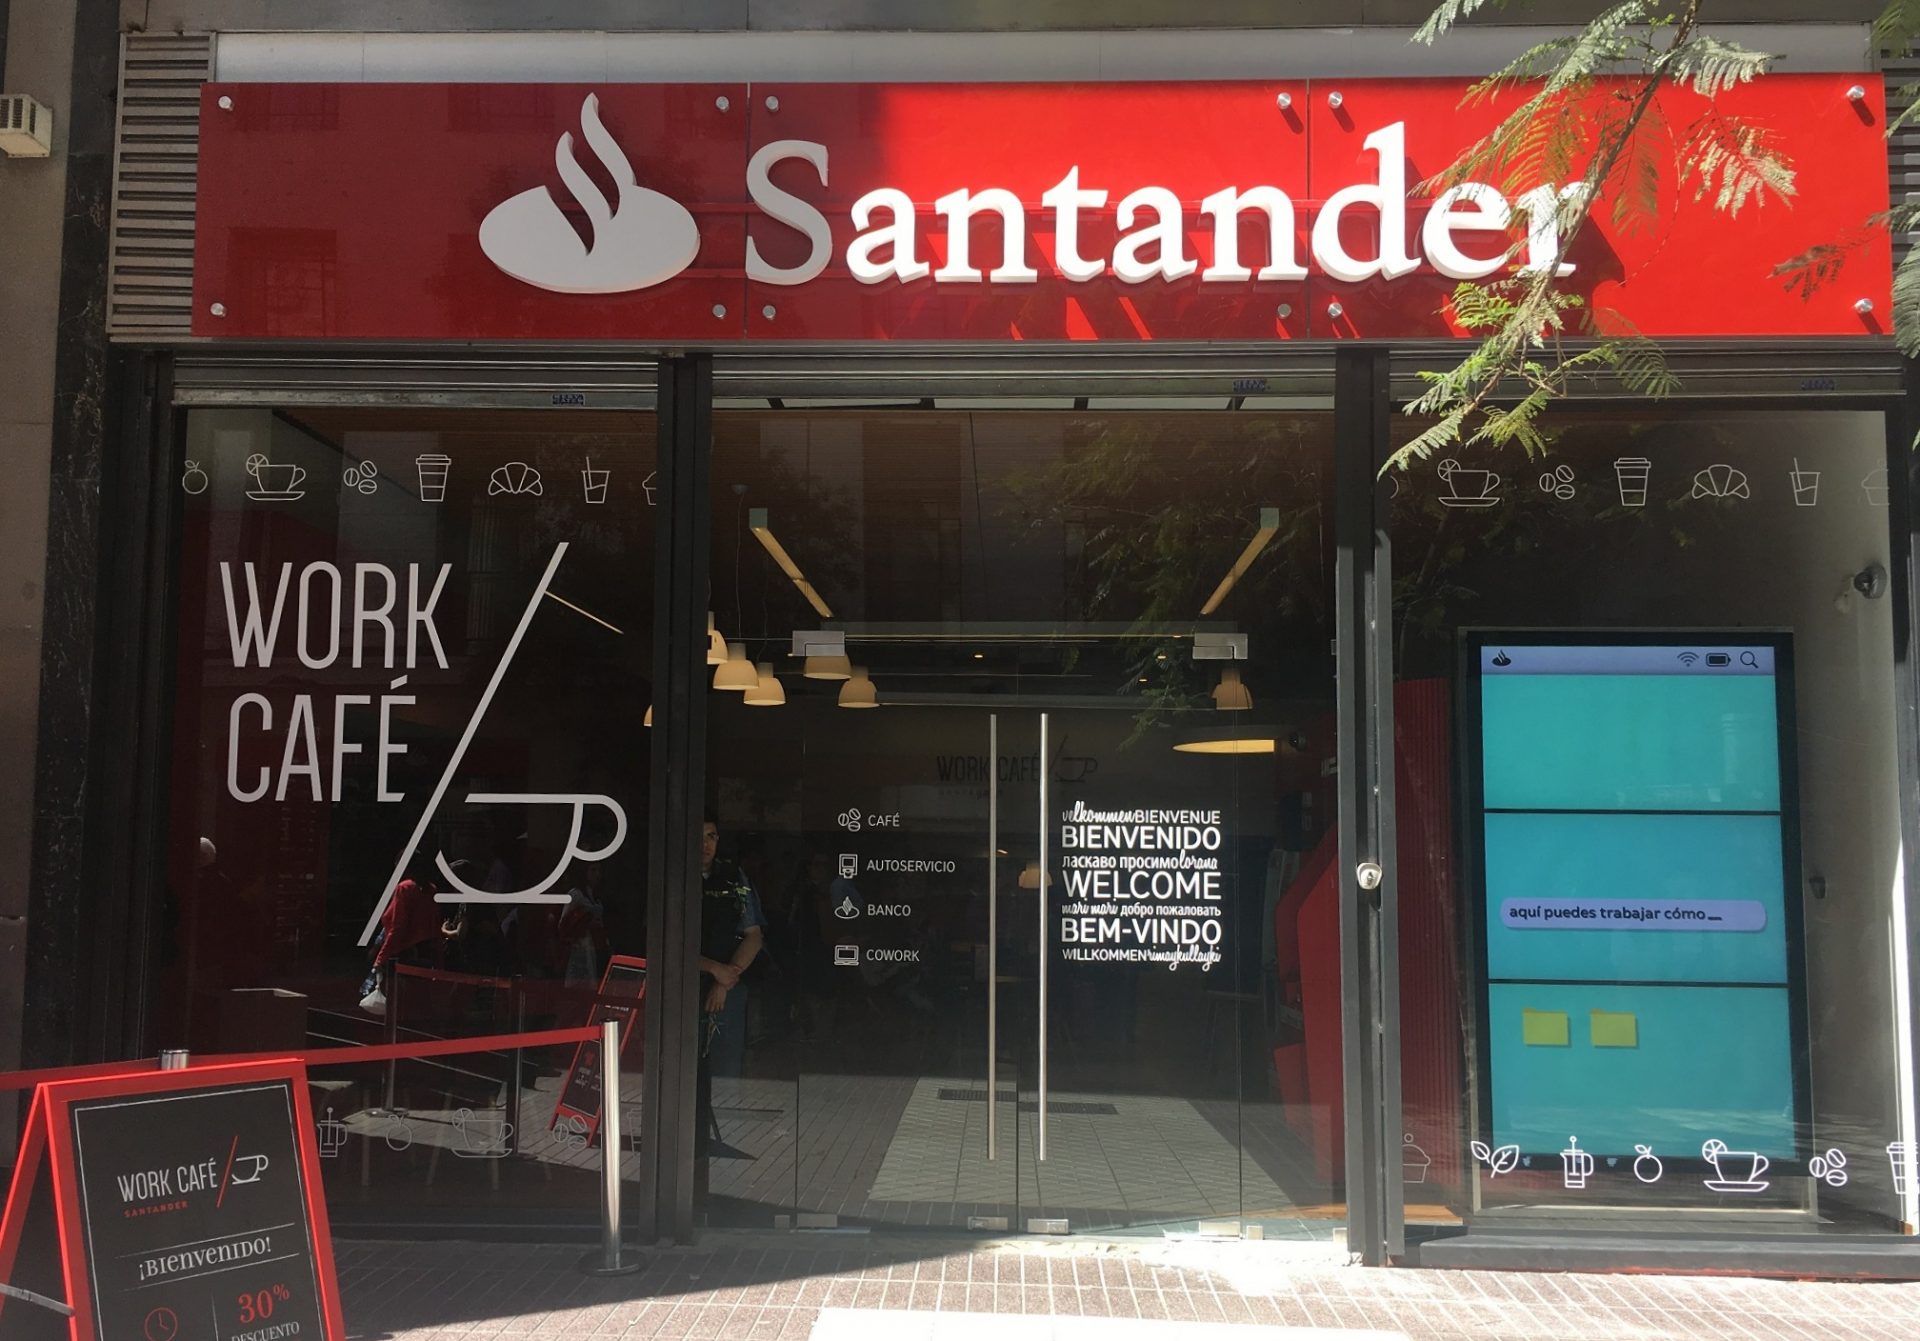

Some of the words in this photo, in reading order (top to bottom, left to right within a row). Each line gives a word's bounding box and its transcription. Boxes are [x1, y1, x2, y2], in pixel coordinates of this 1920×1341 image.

[745, 121, 1590, 287] Santander
[220, 561, 452, 670] WORK
[227, 674, 416, 802] CAFÉ
[937, 755, 990, 782] WORK
[867, 812, 900, 828] CAFÉ
[1134, 809, 1221, 825] BIENVENUE
[1061, 825, 1221, 850] BIENVENIDO
[866, 859, 956, 873] AUTOSERVICIO
[1062, 870, 1222, 900] WELCOME
[867, 904, 911, 917] BANCO
[1120, 902, 1154, 918] добро
[1155, 904, 1222, 917] пожаловать
[1509, 905, 1541, 922] aquí
[1543, 905, 1597, 922] puedes
[1599, 906, 1660, 924] trabajar
[1061, 917, 1222, 945] BEM-VINDO
[866, 948, 920, 962] COWORK
[1062, 948, 1148, 962] WILLKOMMEN
[117, 1167, 173, 1202] WORK
[177, 1158, 218, 1194] CAFÉ
[124, 1200, 189, 1218] SANTANDER
[238, 1283, 290, 1324] 30%
